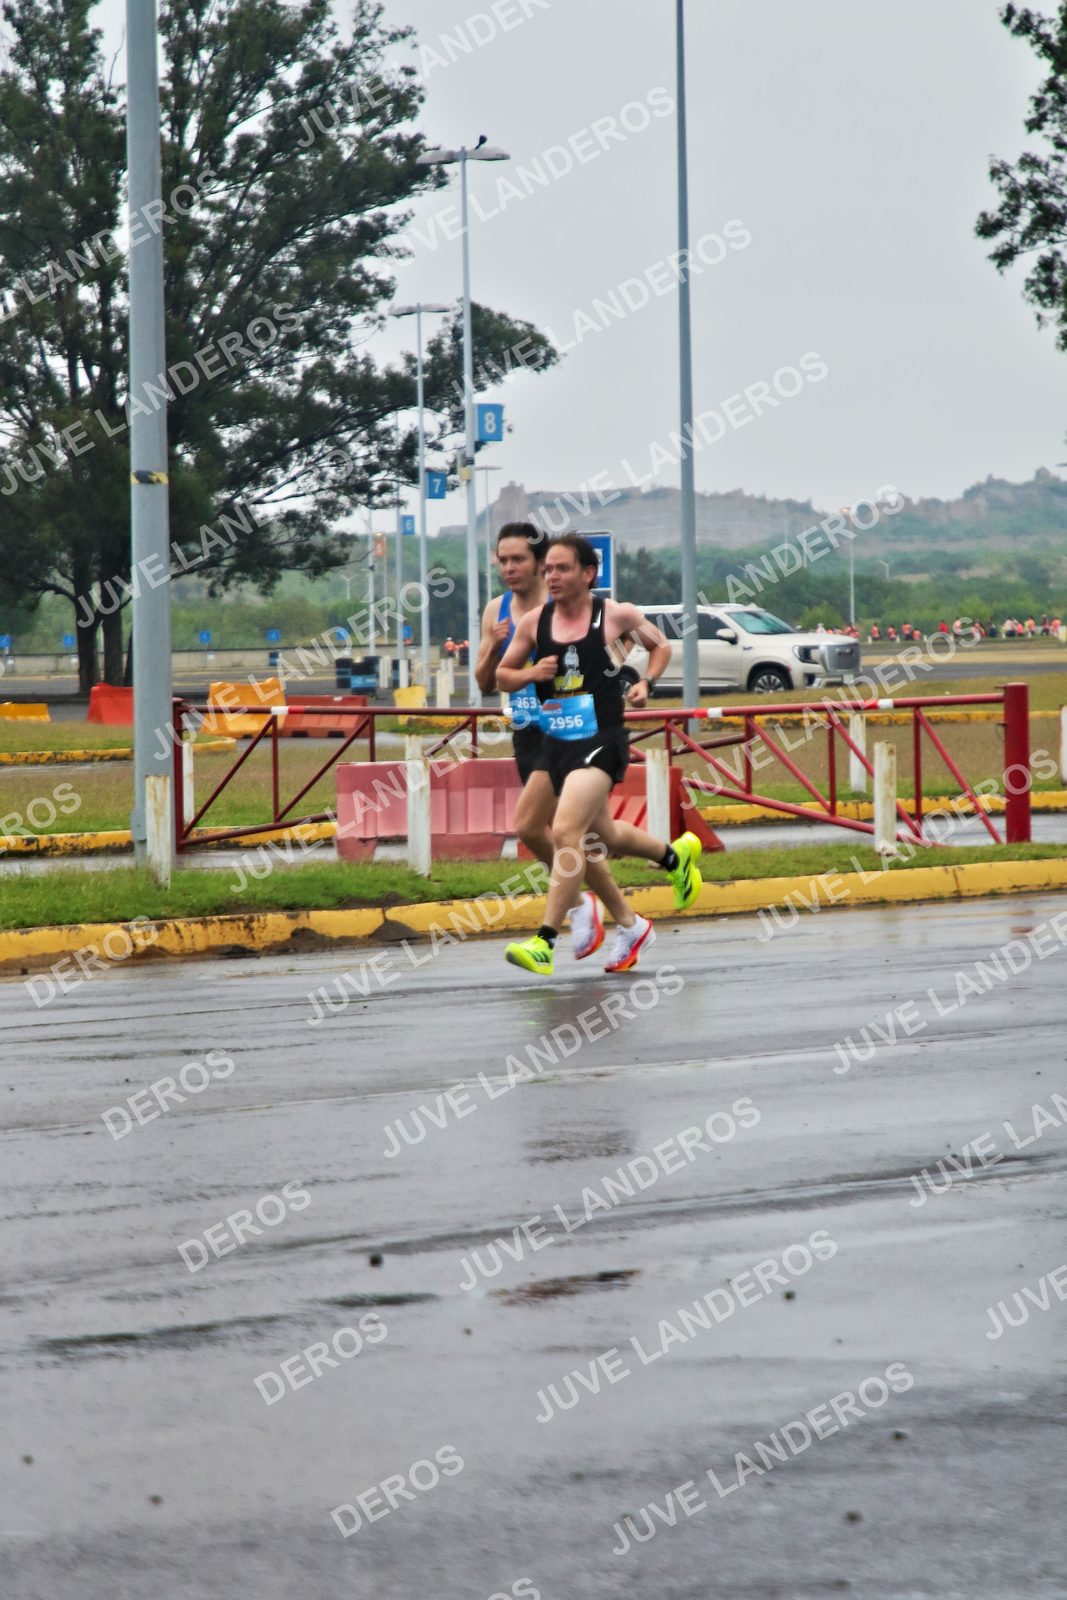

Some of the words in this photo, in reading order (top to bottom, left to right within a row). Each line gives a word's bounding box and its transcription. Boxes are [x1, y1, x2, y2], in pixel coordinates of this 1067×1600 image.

[484, 412, 496, 433] 8
[433, 478, 441, 494] 7
[549, 714, 584, 730] 2956
